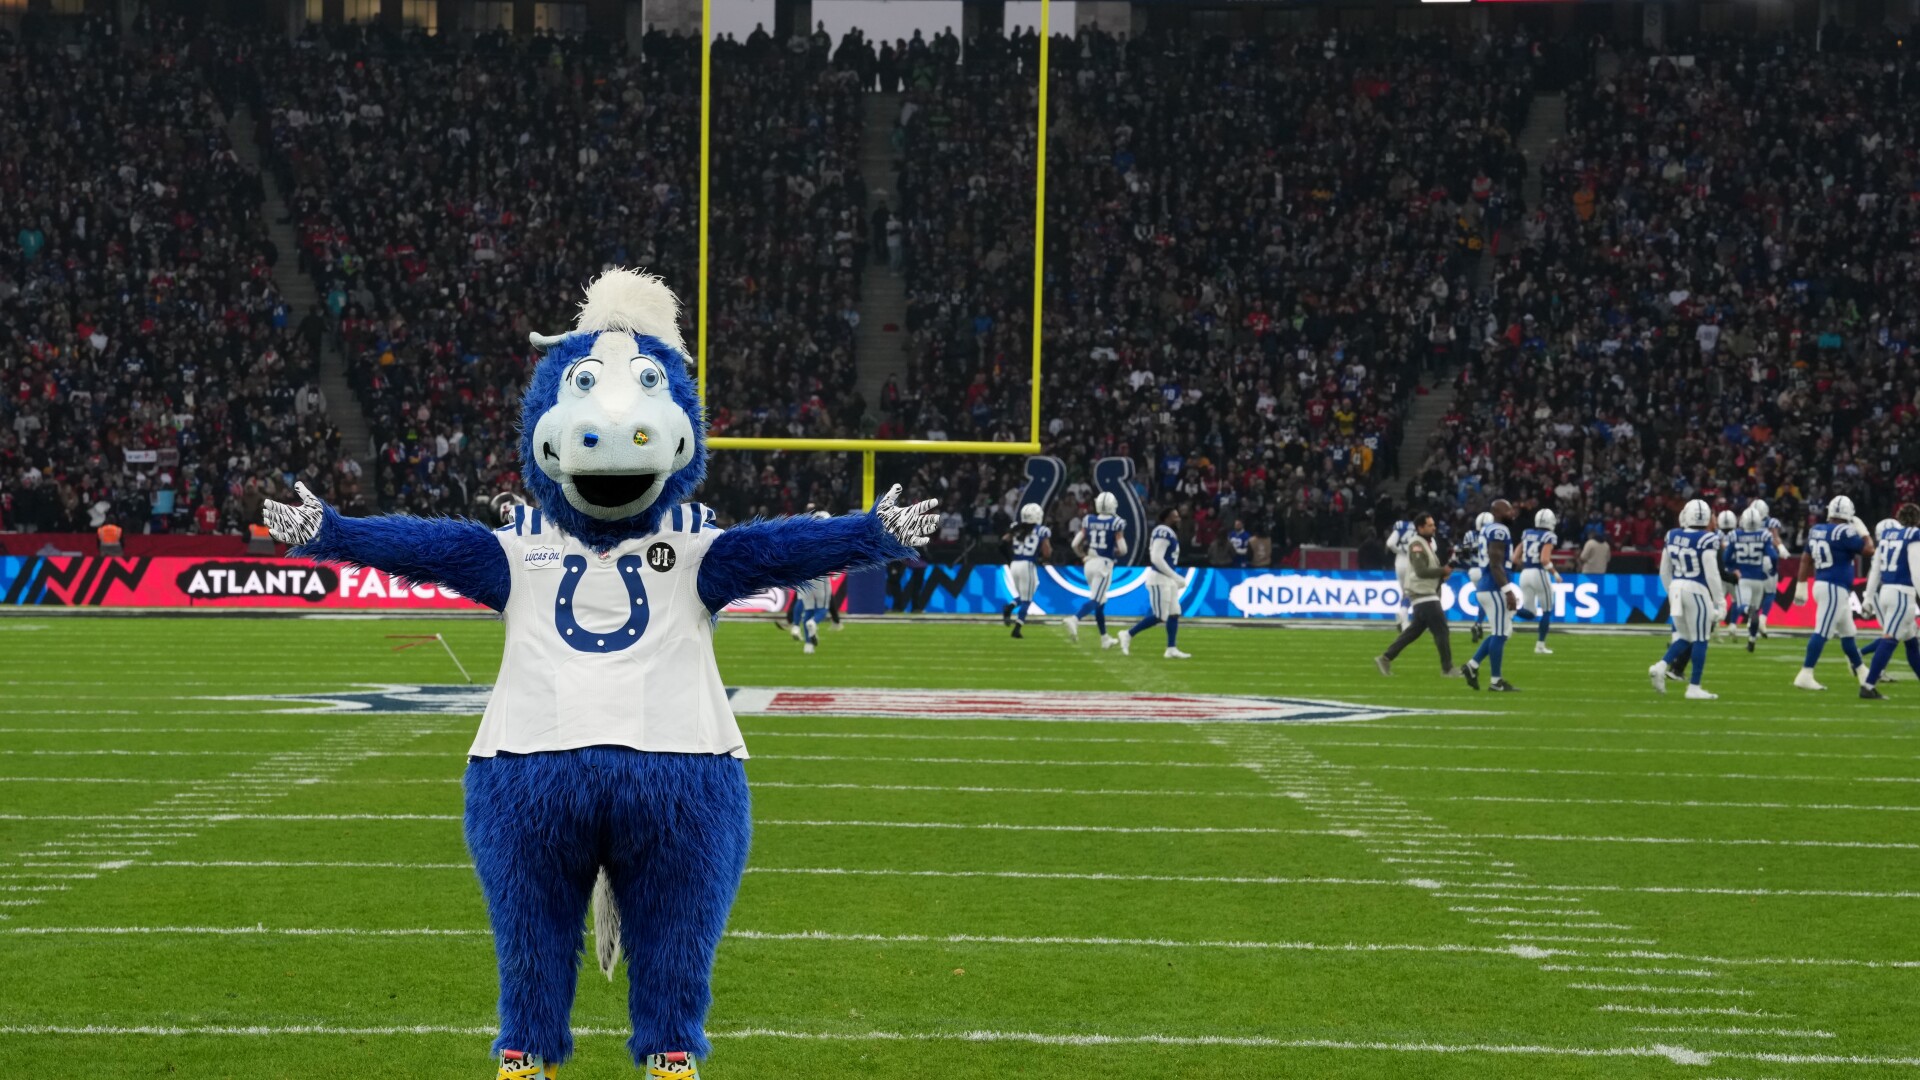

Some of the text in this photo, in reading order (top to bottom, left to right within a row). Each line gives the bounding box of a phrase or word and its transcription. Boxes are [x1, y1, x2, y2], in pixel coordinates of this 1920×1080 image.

[1088, 530, 1108, 549] 11
[1614, 523, 1622, 536] 7
[524, 552, 560, 562] LUCAS OIL
[1522, 539, 1541, 564] 14
[1667, 544, 1700, 578] 50
[1734, 542, 1764, 565] 25
[187, 566, 462, 599] ATLANTA FALC
[1247, 582, 1600, 619] INDIANAPO CTS
